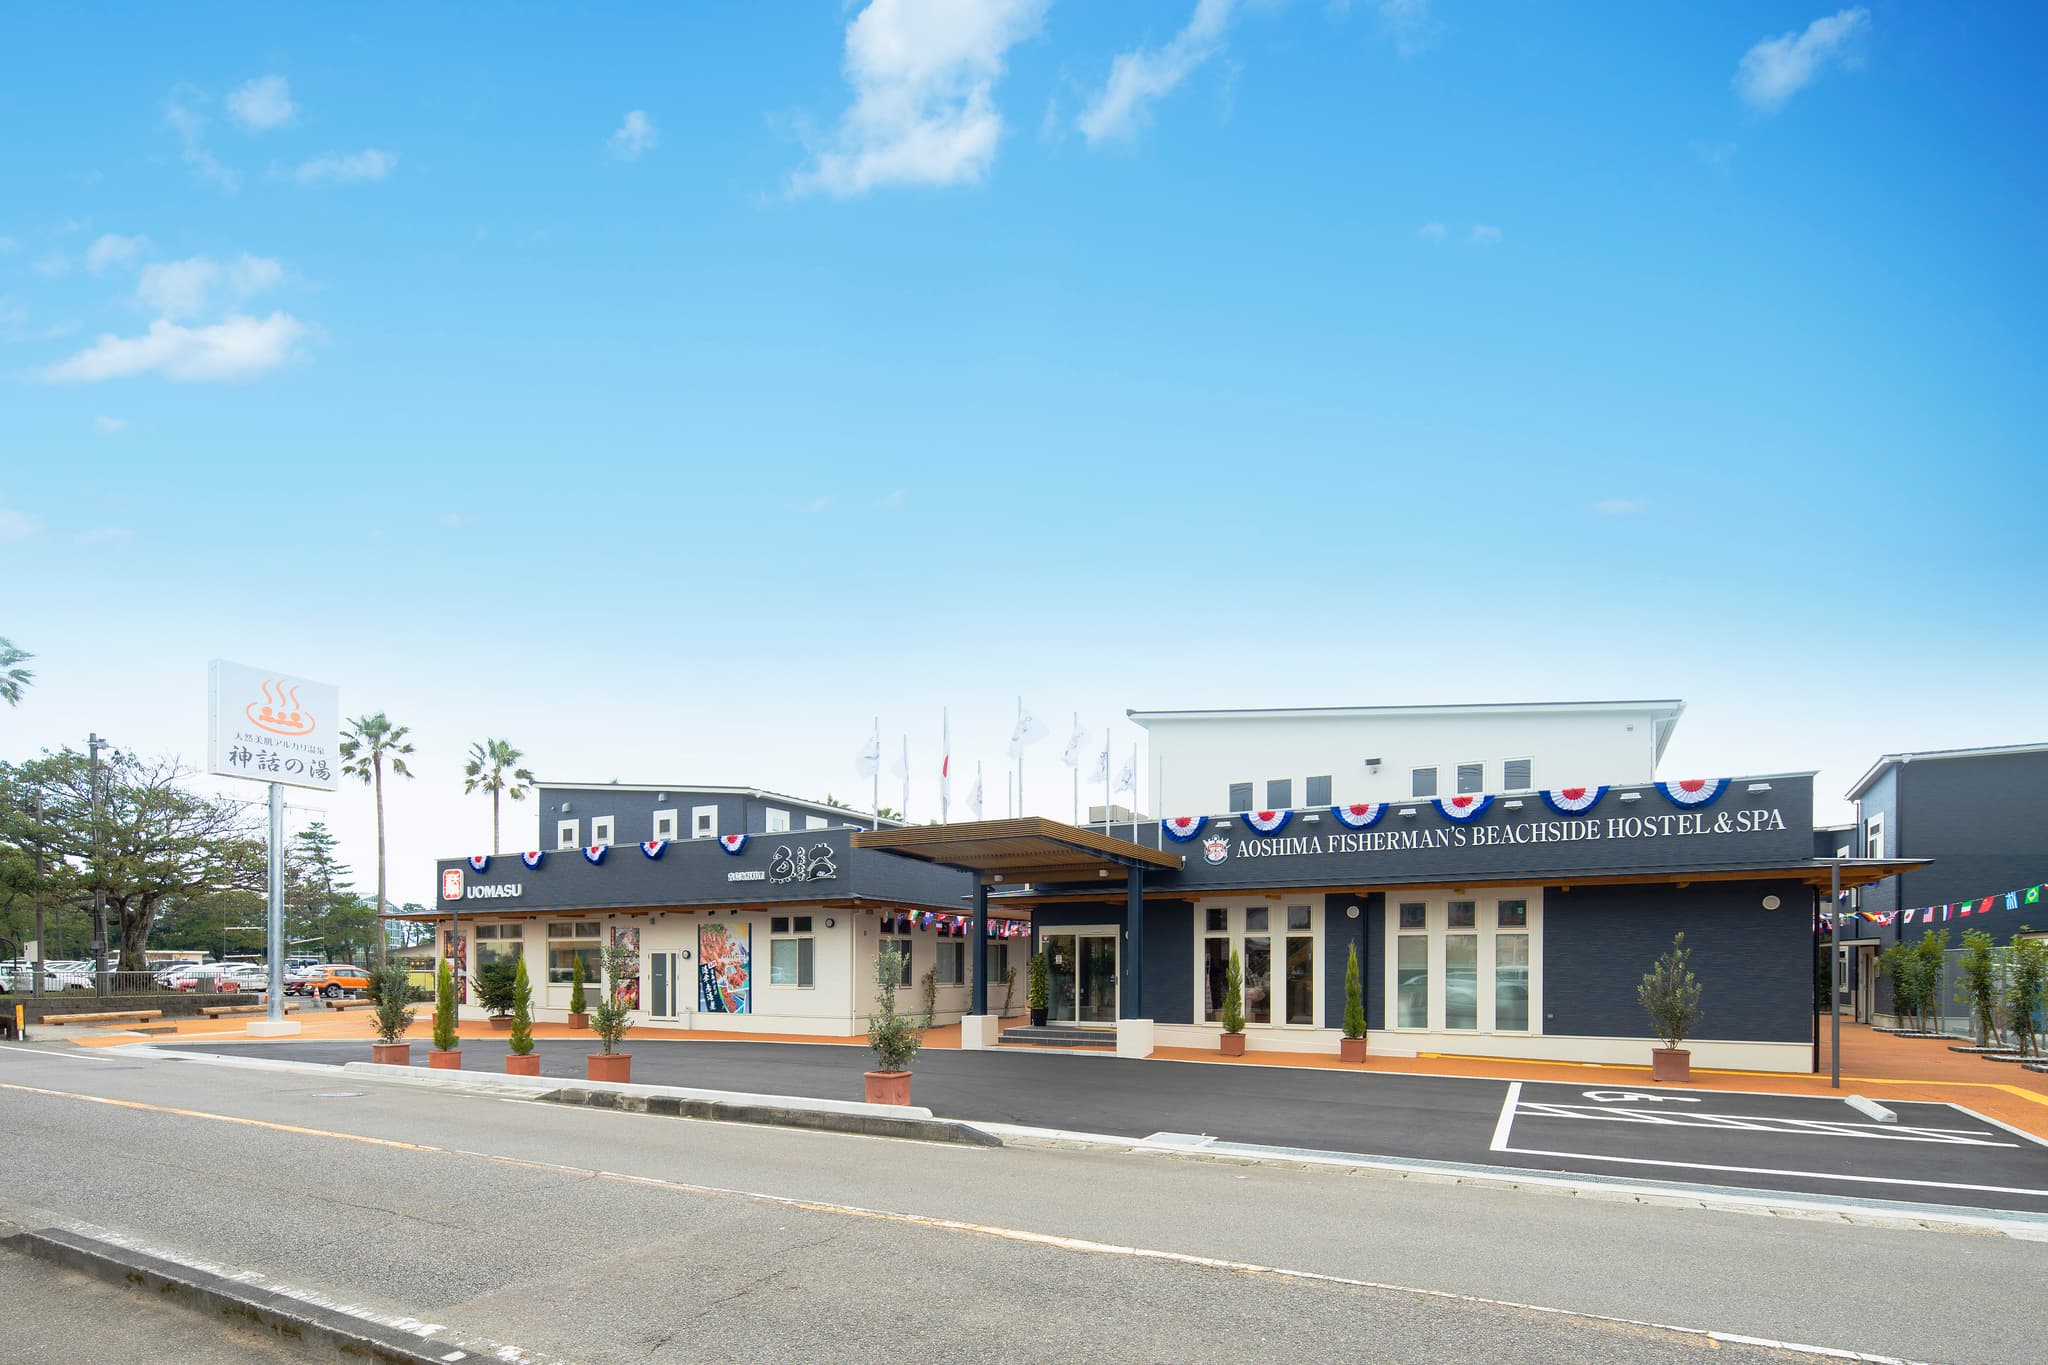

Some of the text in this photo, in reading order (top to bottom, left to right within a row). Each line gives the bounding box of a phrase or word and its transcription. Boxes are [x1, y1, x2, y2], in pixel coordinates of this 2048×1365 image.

[229, 745, 331, 780] 神話の湯
[1236, 836, 1322, 858] AOSHIMA
[1327, 826, 1466, 853] FISHERMAN'S
[1472, 819, 1600, 846] BEACHSIDE
[467, 883, 522, 899] UOMASU
